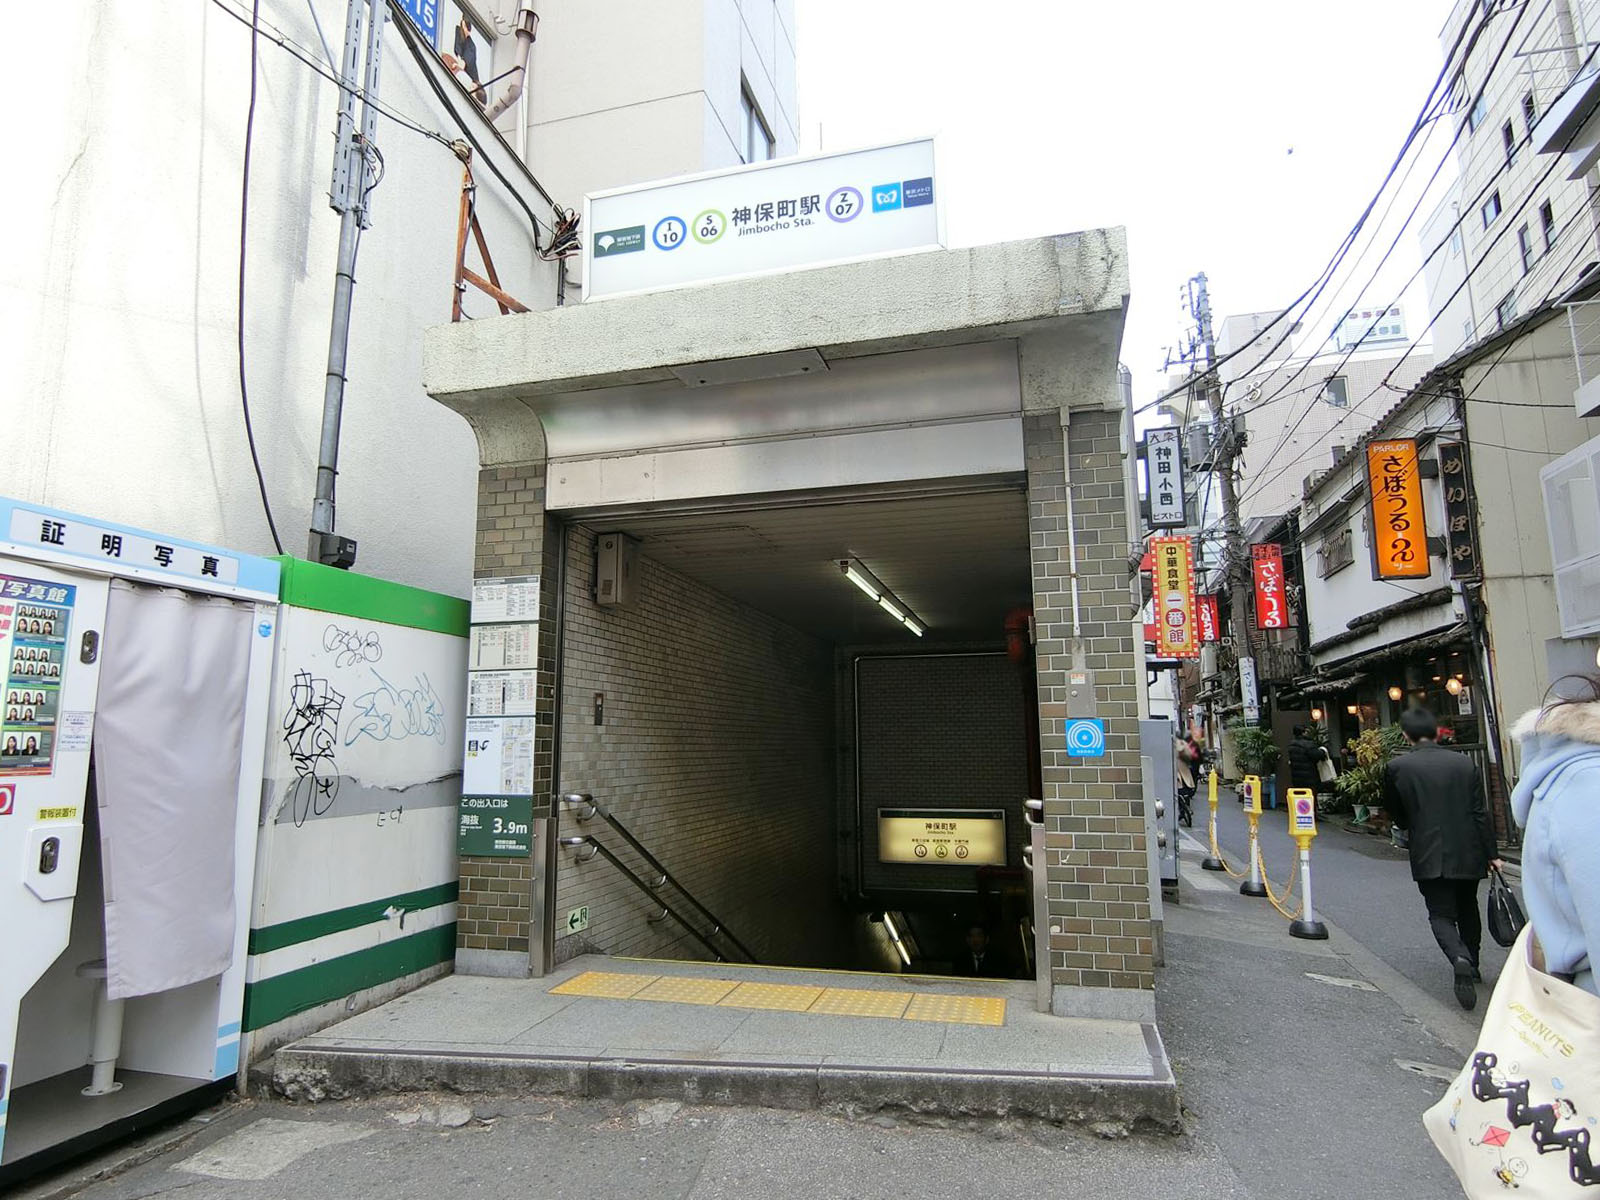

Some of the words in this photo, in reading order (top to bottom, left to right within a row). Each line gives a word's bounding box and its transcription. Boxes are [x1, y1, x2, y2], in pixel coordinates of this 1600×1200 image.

[840, 192, 849, 203] Z
[731, 194, 821, 226] 神保町駅
[835, 203, 854, 216] 07
[705, 215, 713, 225] S
[700, 225, 718, 237] 06
[738, 220, 790, 237] Jimbocho
[794, 217, 816, 229] Sta.
[662, 231, 679, 243] 10
[1150, 431, 1175, 443] 大衆
[1373, 443, 1409, 453] PARLOR
[1155, 446, 1174, 506] 神田小西
[1153, 511, 1182, 520] ビストロ
[41, 519, 219, 577] 証明写真
[1259, 561, 1281, 628] さぼうる
[461, 799, 509, 808] この出入口は
[460, 814, 480, 825] 海抜
[493, 817, 528, 834] 3.9m
[925, 822, 957, 830] 神保町駅
[1508, 1002, 1575, 1057] PEANUTS
